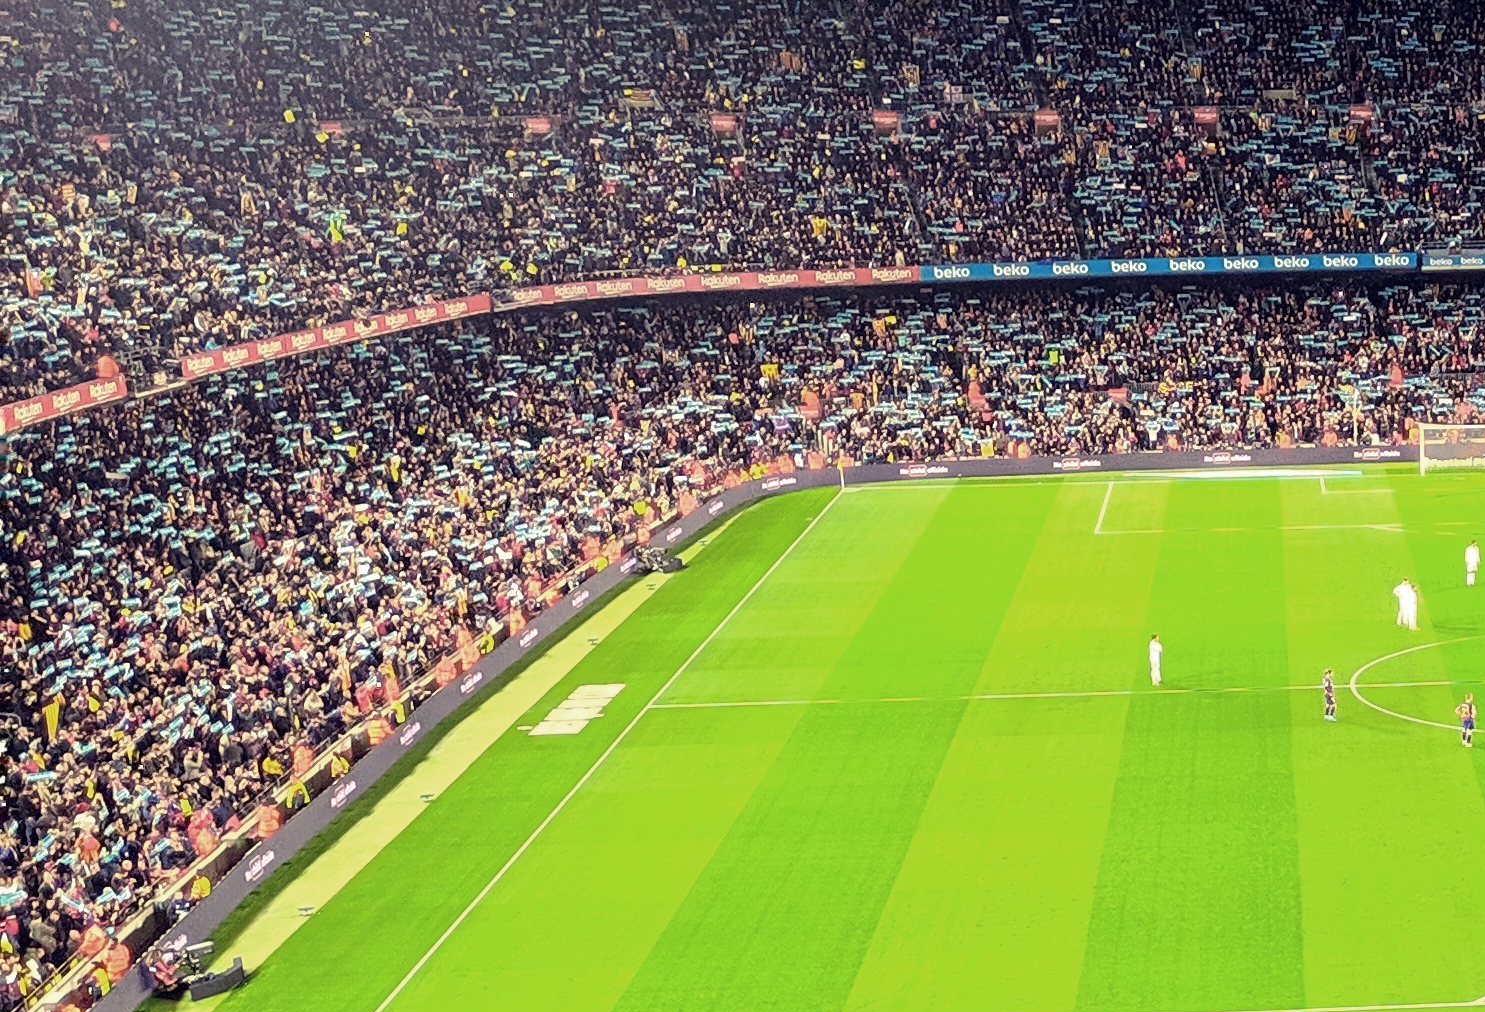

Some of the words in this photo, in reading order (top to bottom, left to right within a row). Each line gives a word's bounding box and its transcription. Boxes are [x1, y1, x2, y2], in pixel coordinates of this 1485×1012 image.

[1170, 259, 1205, 271] beko
[1223, 258, 1259, 269] beko
[1274, 256, 1309, 267] beko
[1323, 255, 1358, 267] beko
[1375, 254, 1409, 266] beko
[1430, 257, 1453, 266] beko
[1460, 256, 1483, 265] beko
[934, 266, 970, 278] beko
[993, 264, 1029, 276] beko
[1052, 262, 1088, 274] beko
[1111, 261, 1147, 272] beko
[758, 272, 798, 284] Rakuten
[816, 269, 855, 282] Rakuten
[872, 267, 911, 280] Rakuten
[596, 280, 632, 293] Rakuten
[647, 277, 685, 290] Rakuten
[701, 275, 740, 287] Rakuten
